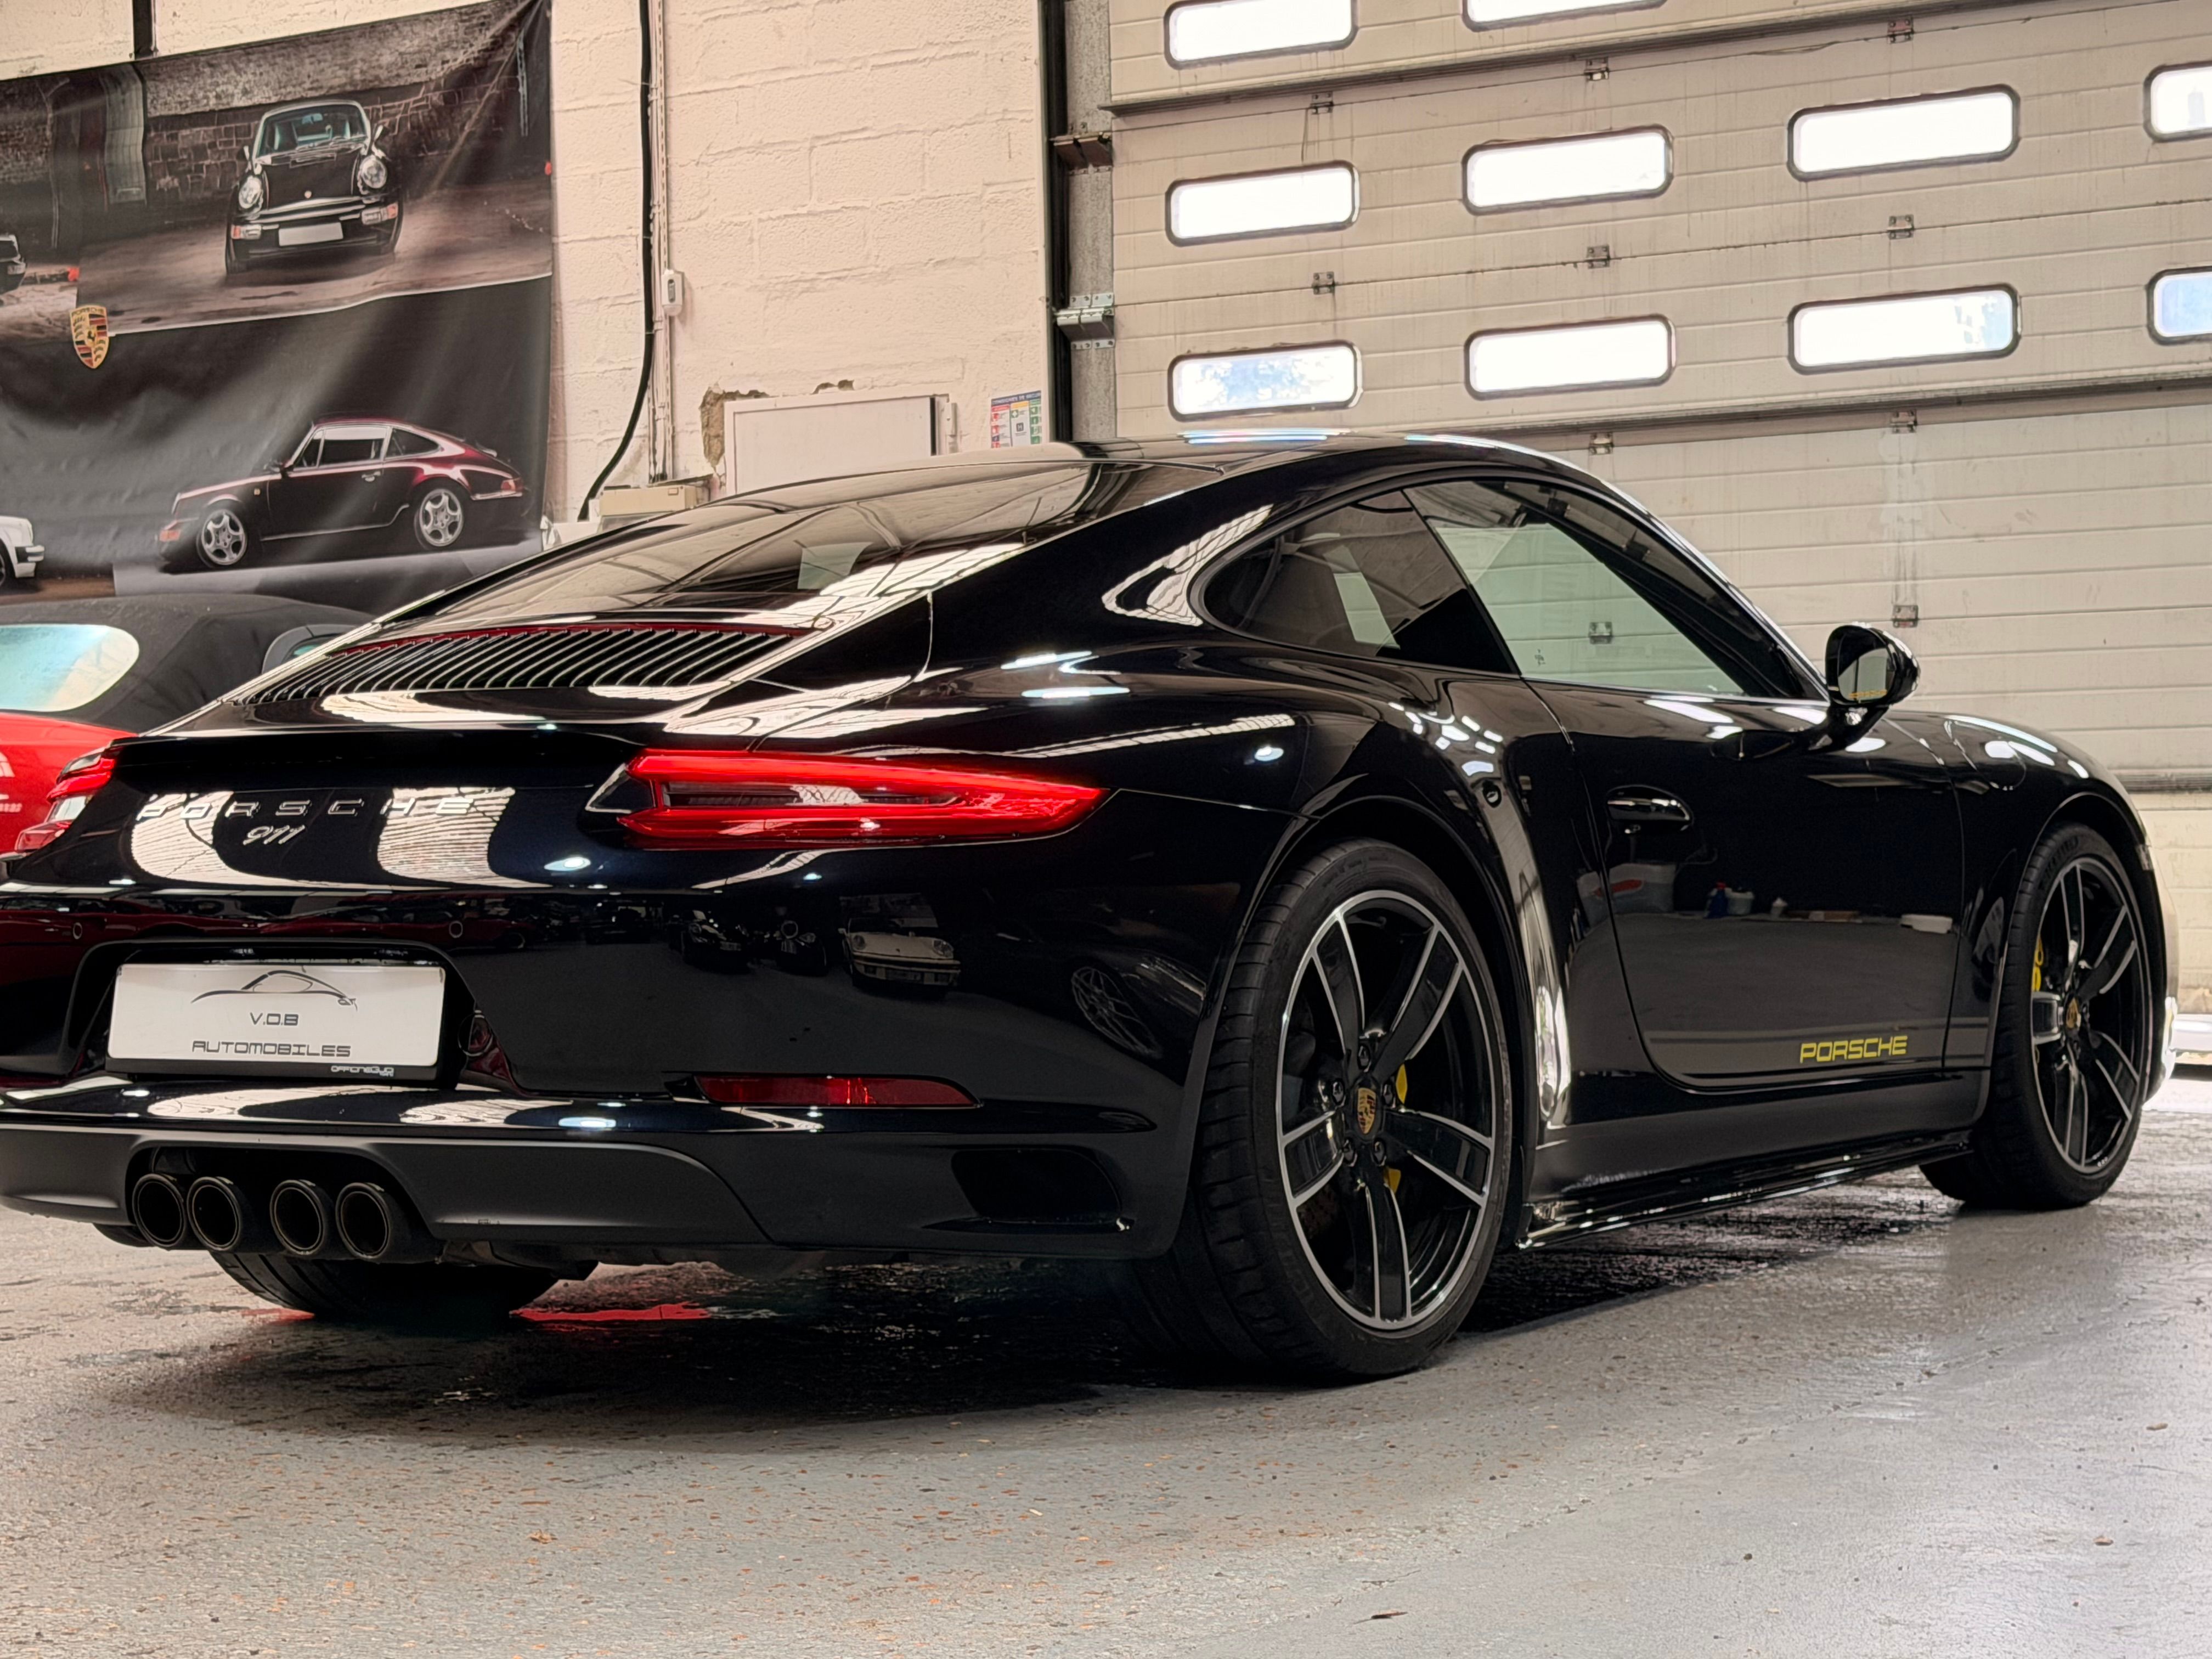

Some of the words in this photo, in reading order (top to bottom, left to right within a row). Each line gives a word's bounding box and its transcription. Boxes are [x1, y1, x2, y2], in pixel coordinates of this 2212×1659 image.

[136, 797, 474, 821] PORSCHE
[242, 825, 305, 845] 911
[192, 1040, 351, 1057] AUTOMOBILES
[1799, 1035, 1908, 1064] PORSCHE
